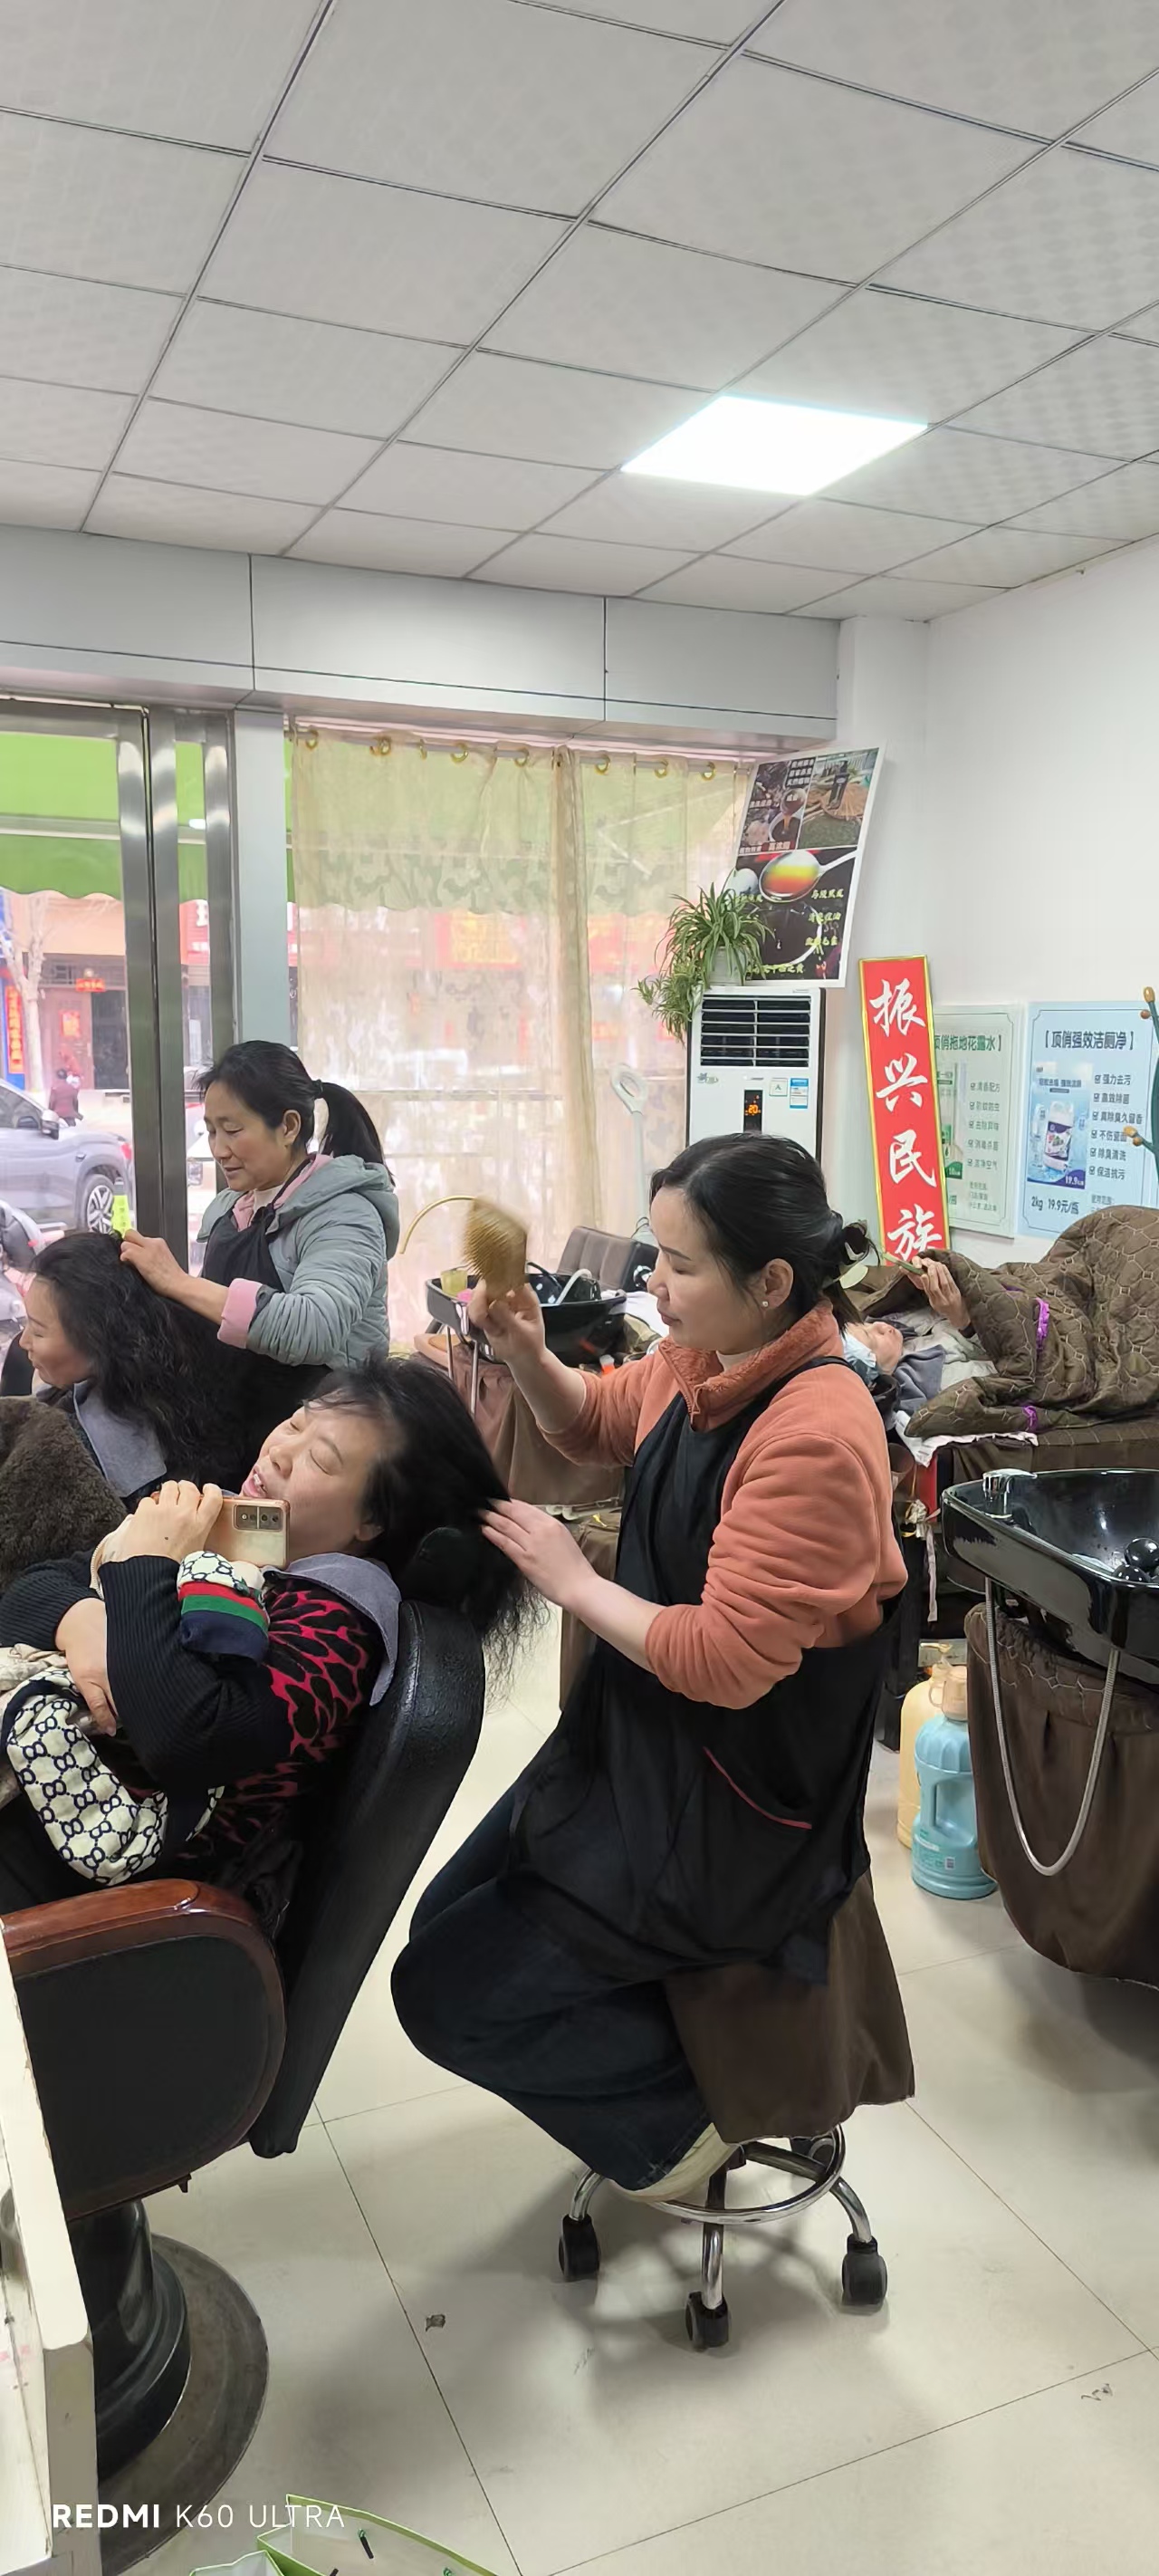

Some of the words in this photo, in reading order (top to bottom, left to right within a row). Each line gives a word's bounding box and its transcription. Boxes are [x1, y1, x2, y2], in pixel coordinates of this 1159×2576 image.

[1103, 1073, 1131, 1085] 强力去污
[869, 978, 942, 1260] 振兴民族
[1031, 1196, 1043, 1211] 2kg
